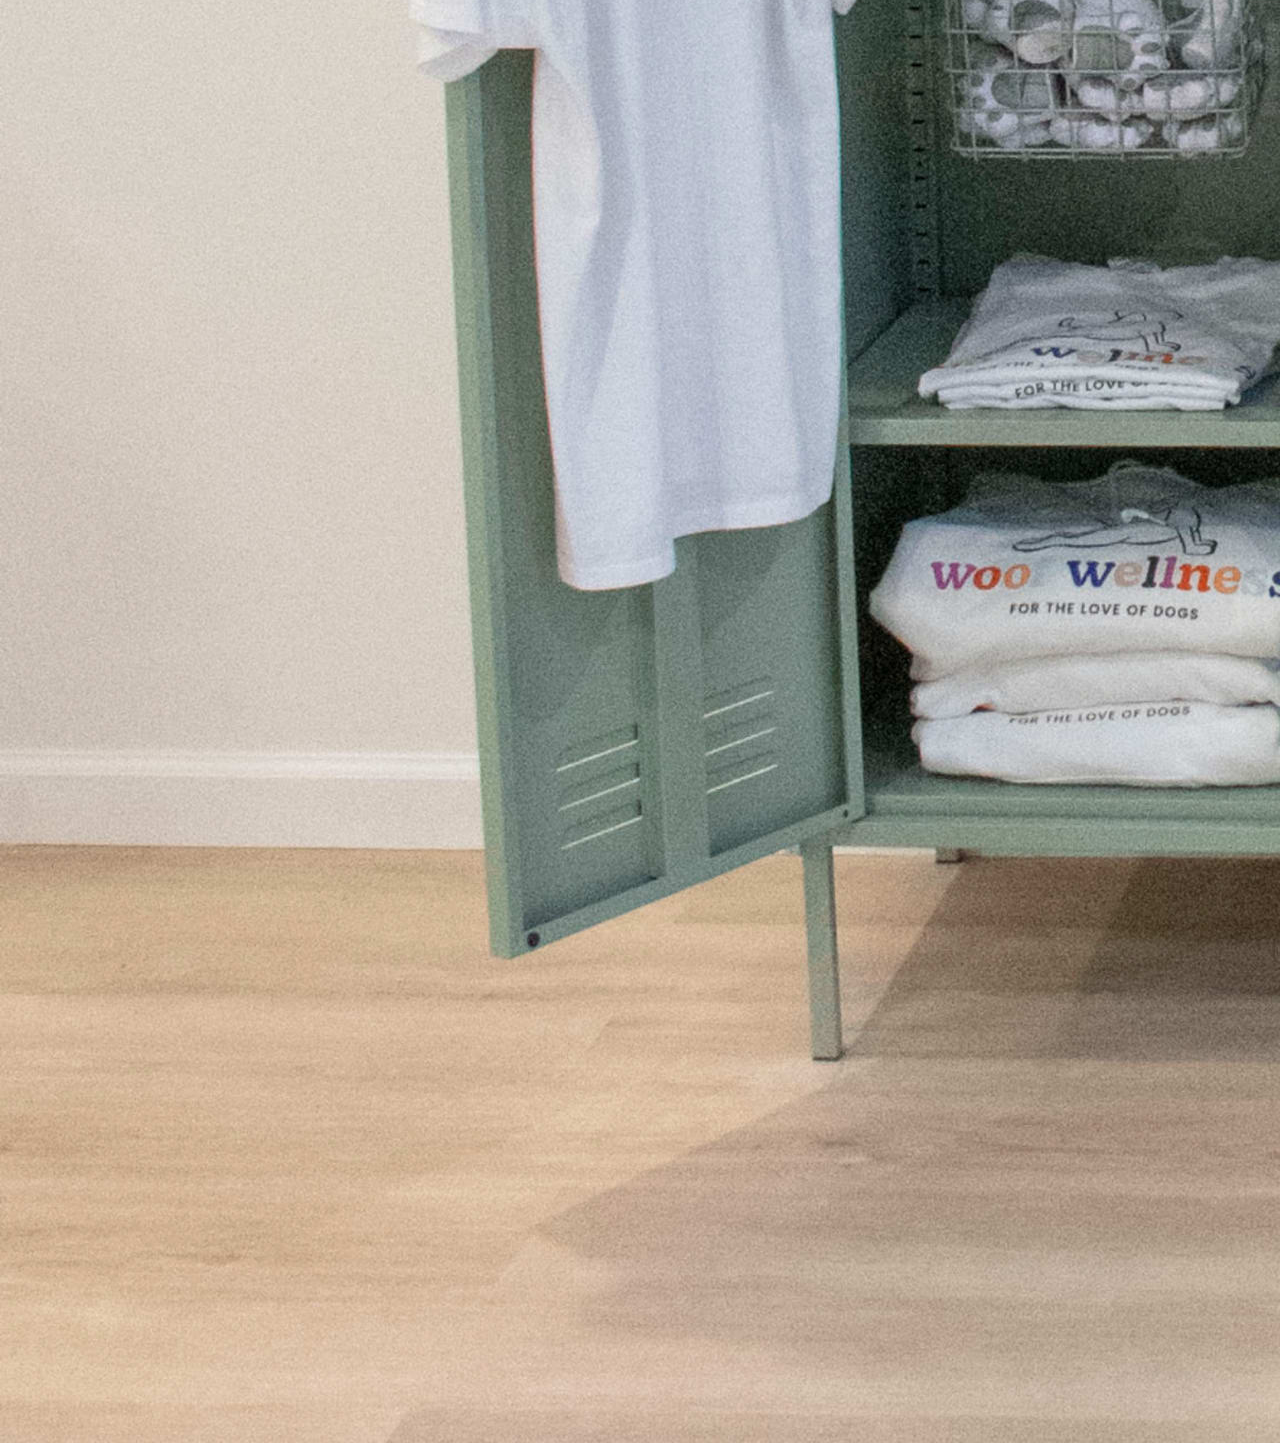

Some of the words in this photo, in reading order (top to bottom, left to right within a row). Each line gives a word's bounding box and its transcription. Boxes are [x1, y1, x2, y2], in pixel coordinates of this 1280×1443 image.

[1015, 385, 1046, 399] FOR
[1051, 379, 1080, 392] THE
[1085, 379, 1125, 392] LOVE
[1009, 602, 1040, 614] FOR
[1047, 602, 1075, 614] THE
[1080, 602, 1121, 615] LOVE
[1126, 604, 1148, 616] OF
[1153, 605, 1199, 620] DOGS
[1045, 714, 1072, 723] THE
[1078, 710, 1115, 722] LOVE
[1121, 709, 1141, 719] OF
[1146, 706, 1190, 717] DOGS
